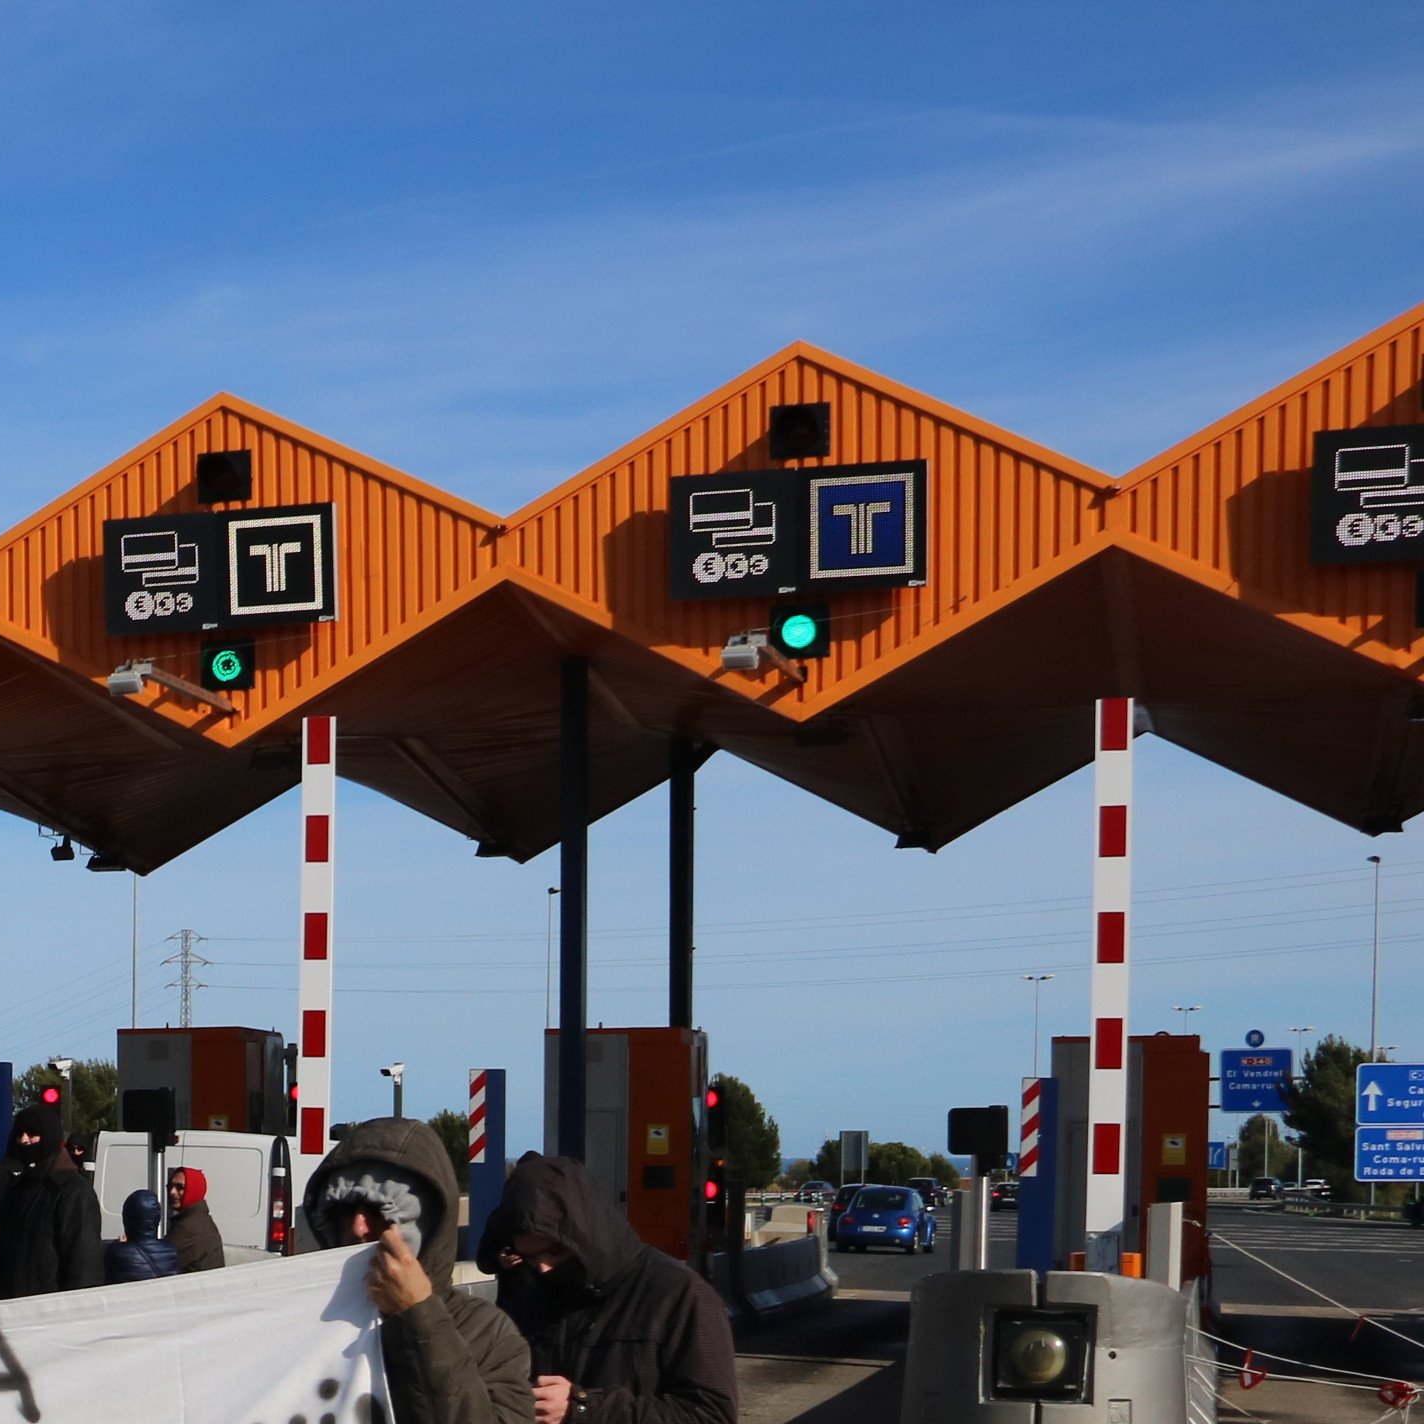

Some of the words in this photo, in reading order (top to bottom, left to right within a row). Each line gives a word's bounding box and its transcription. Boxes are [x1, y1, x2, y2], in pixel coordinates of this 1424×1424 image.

[1226, 1070, 1236, 1078] El
[1243, 1070, 1284, 1078] Vendrel
[1361, 1142, 1391, 1151] Sant
[1396, 1142, 1424, 1151] Salv
[1363, 1167, 1394, 1176] Roda
[1399, 1167, 1414, 1176] de
